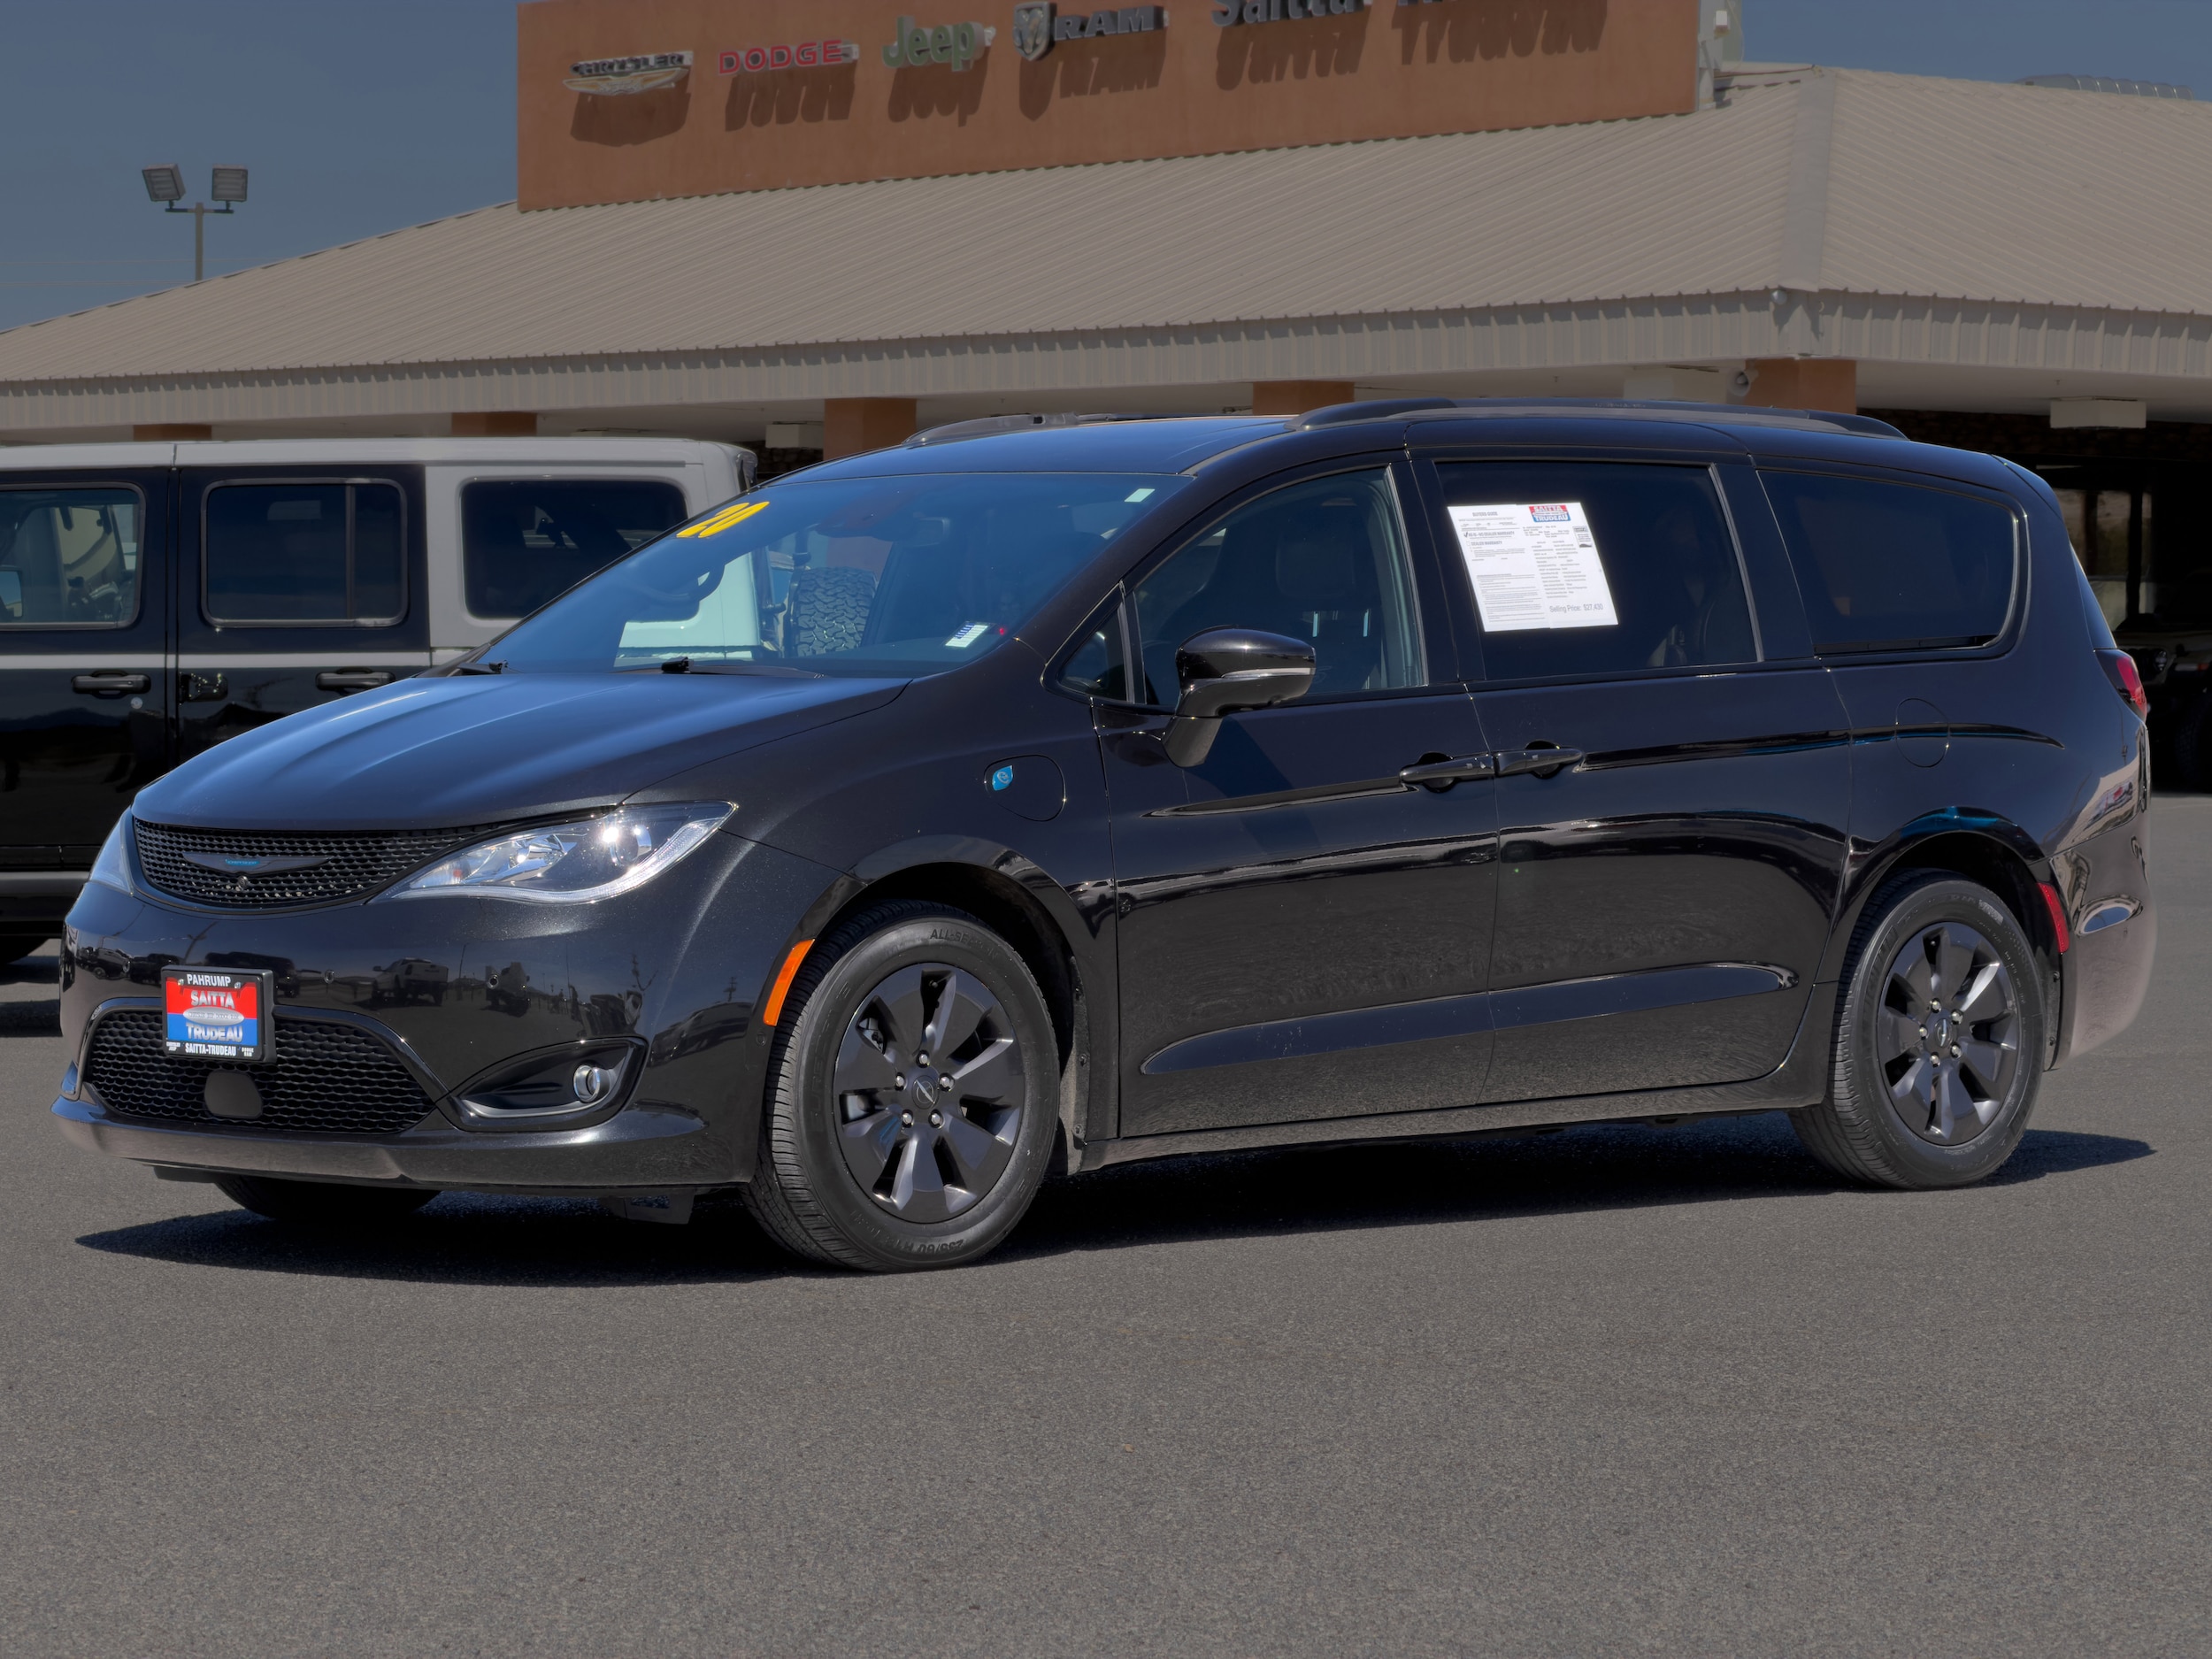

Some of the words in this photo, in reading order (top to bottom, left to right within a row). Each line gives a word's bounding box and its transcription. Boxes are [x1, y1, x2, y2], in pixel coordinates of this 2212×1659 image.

[1054, 5, 1163, 42] RAM
[881, 15, 984, 72] Jeep
[570, 53, 685, 76] CHRYSLER
[718, 40, 842, 74] DODGE
[1534, 513, 1568, 522] TRUDEAU
[186, 974, 231, 987] PAHRUMP
[190, 991, 235, 1009] SAITTA
[186, 1023, 243, 1042] TRUDEAU
[185, 1042, 237, 1056] SAITTA-TRUDEAU
